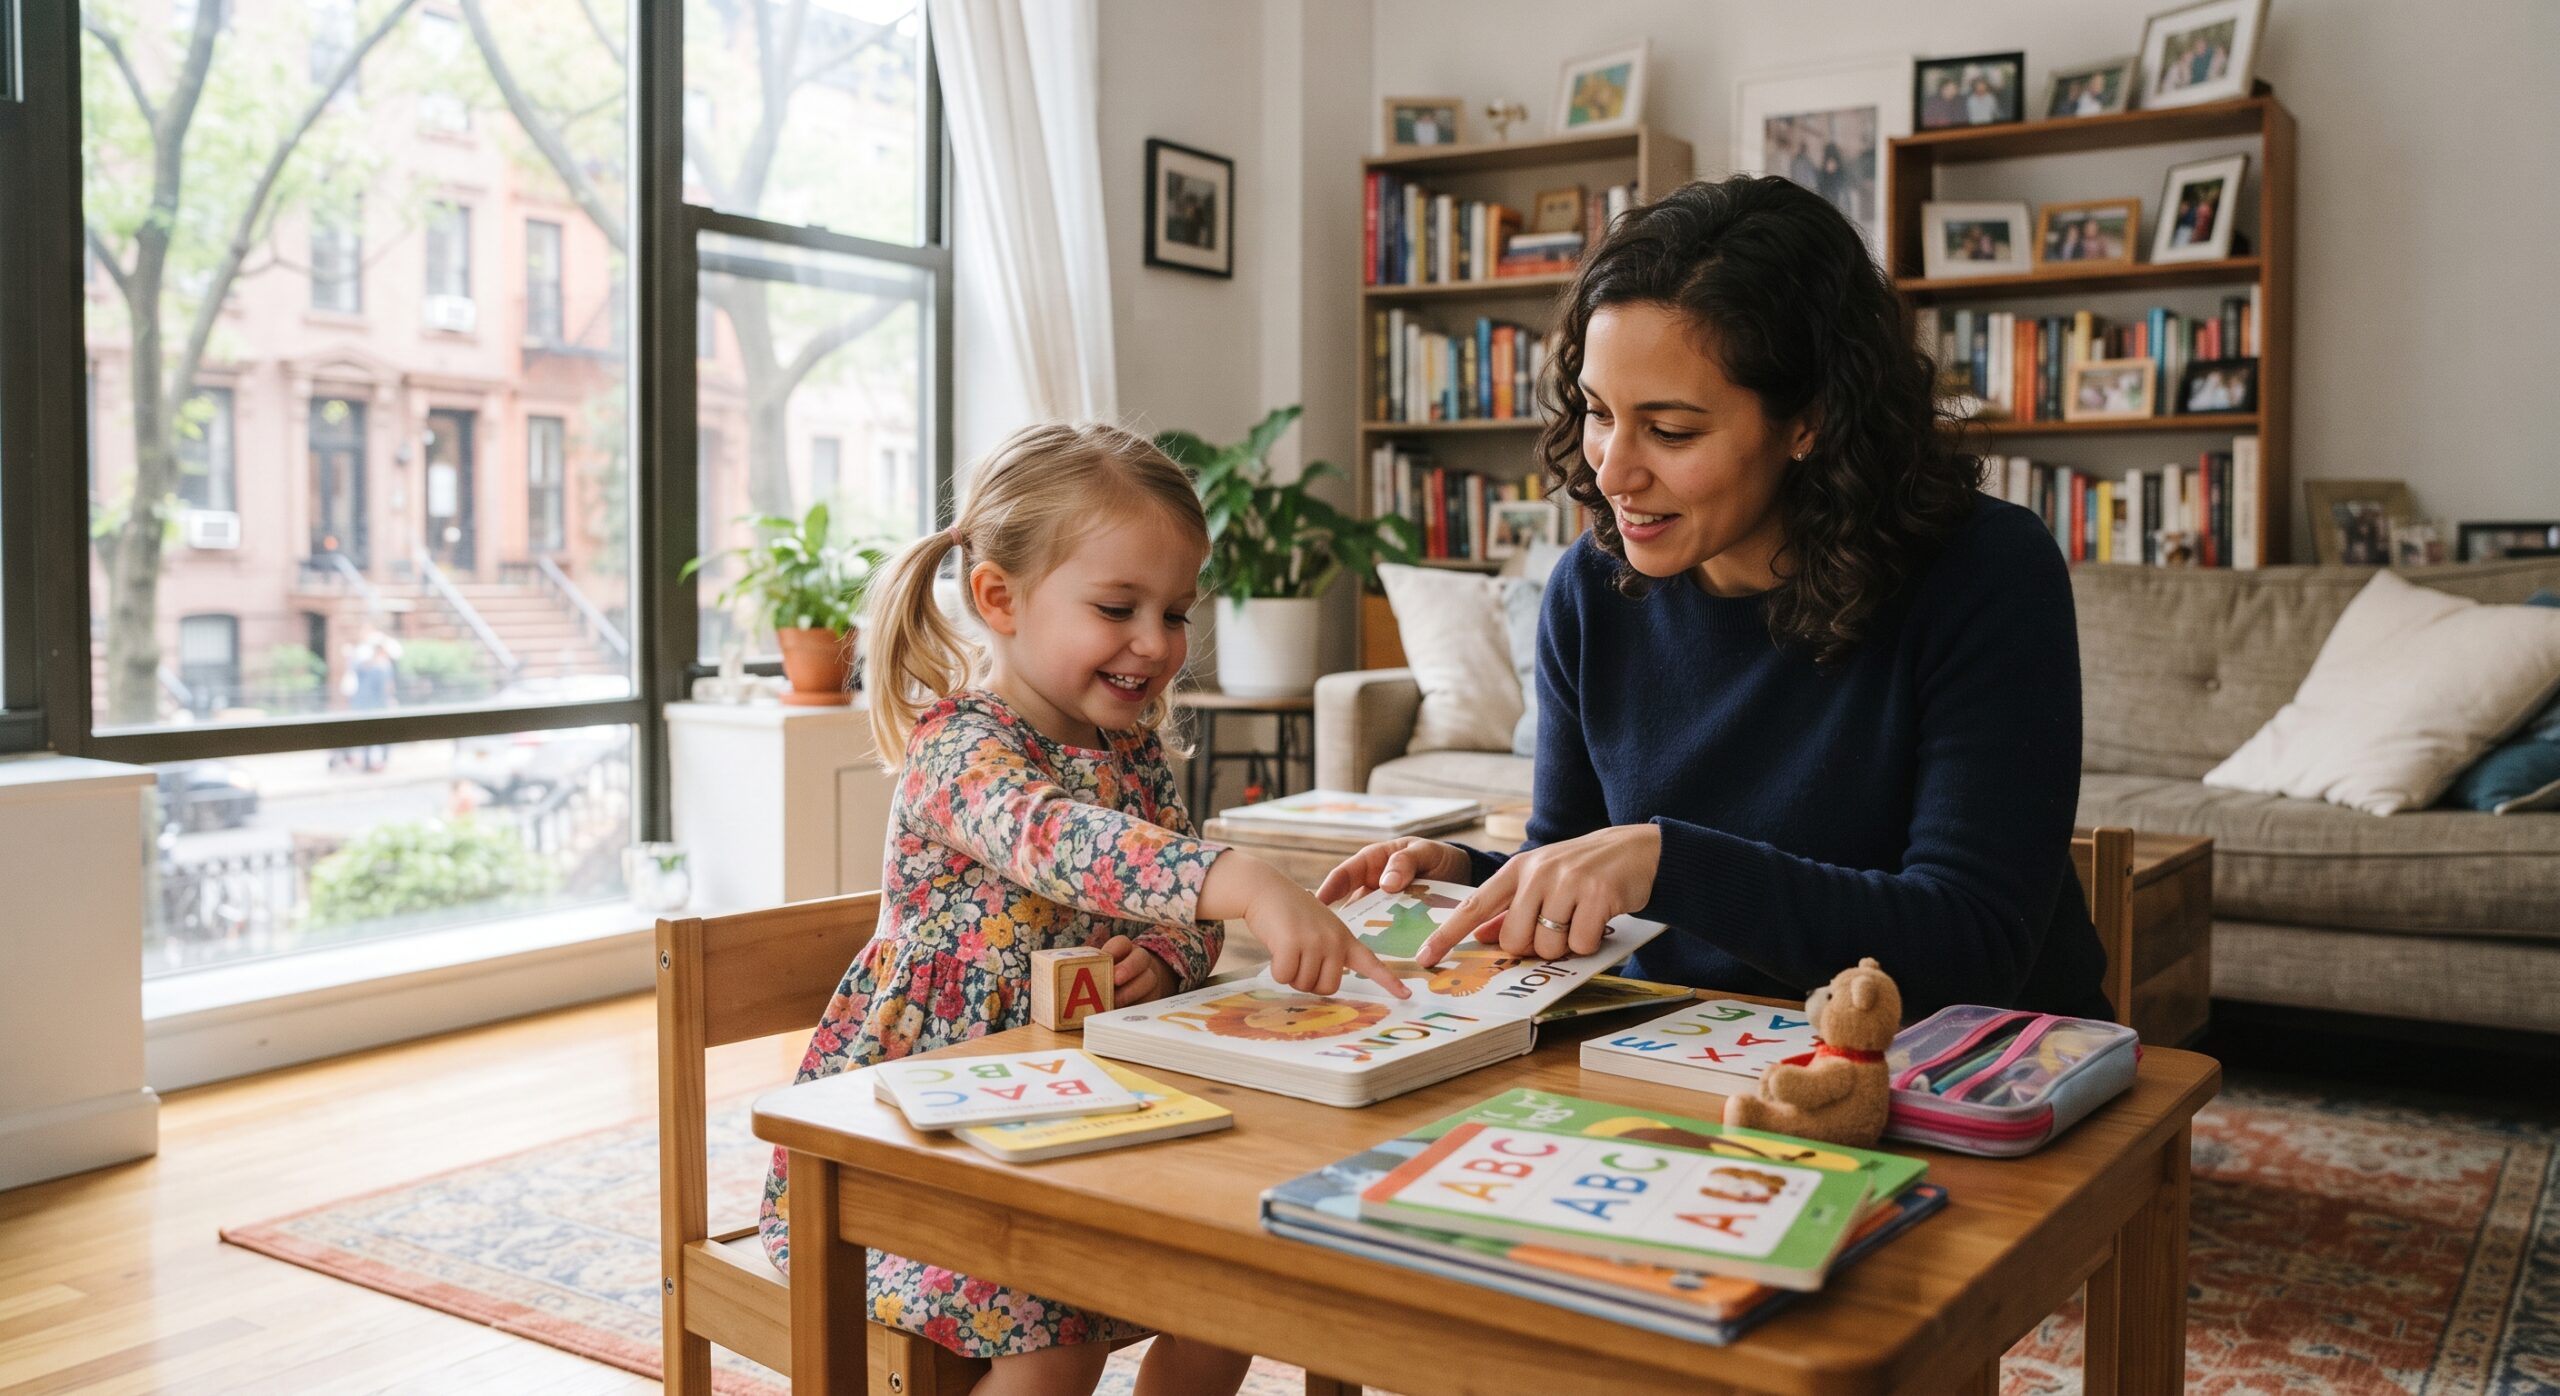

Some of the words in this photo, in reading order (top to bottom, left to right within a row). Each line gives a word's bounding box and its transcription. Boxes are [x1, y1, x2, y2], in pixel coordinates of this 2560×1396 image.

[1063, 967, 1105, 1019] A
[1439, 1137, 1559, 1203] ABC
[1552, 1152, 1669, 1221] ABC
